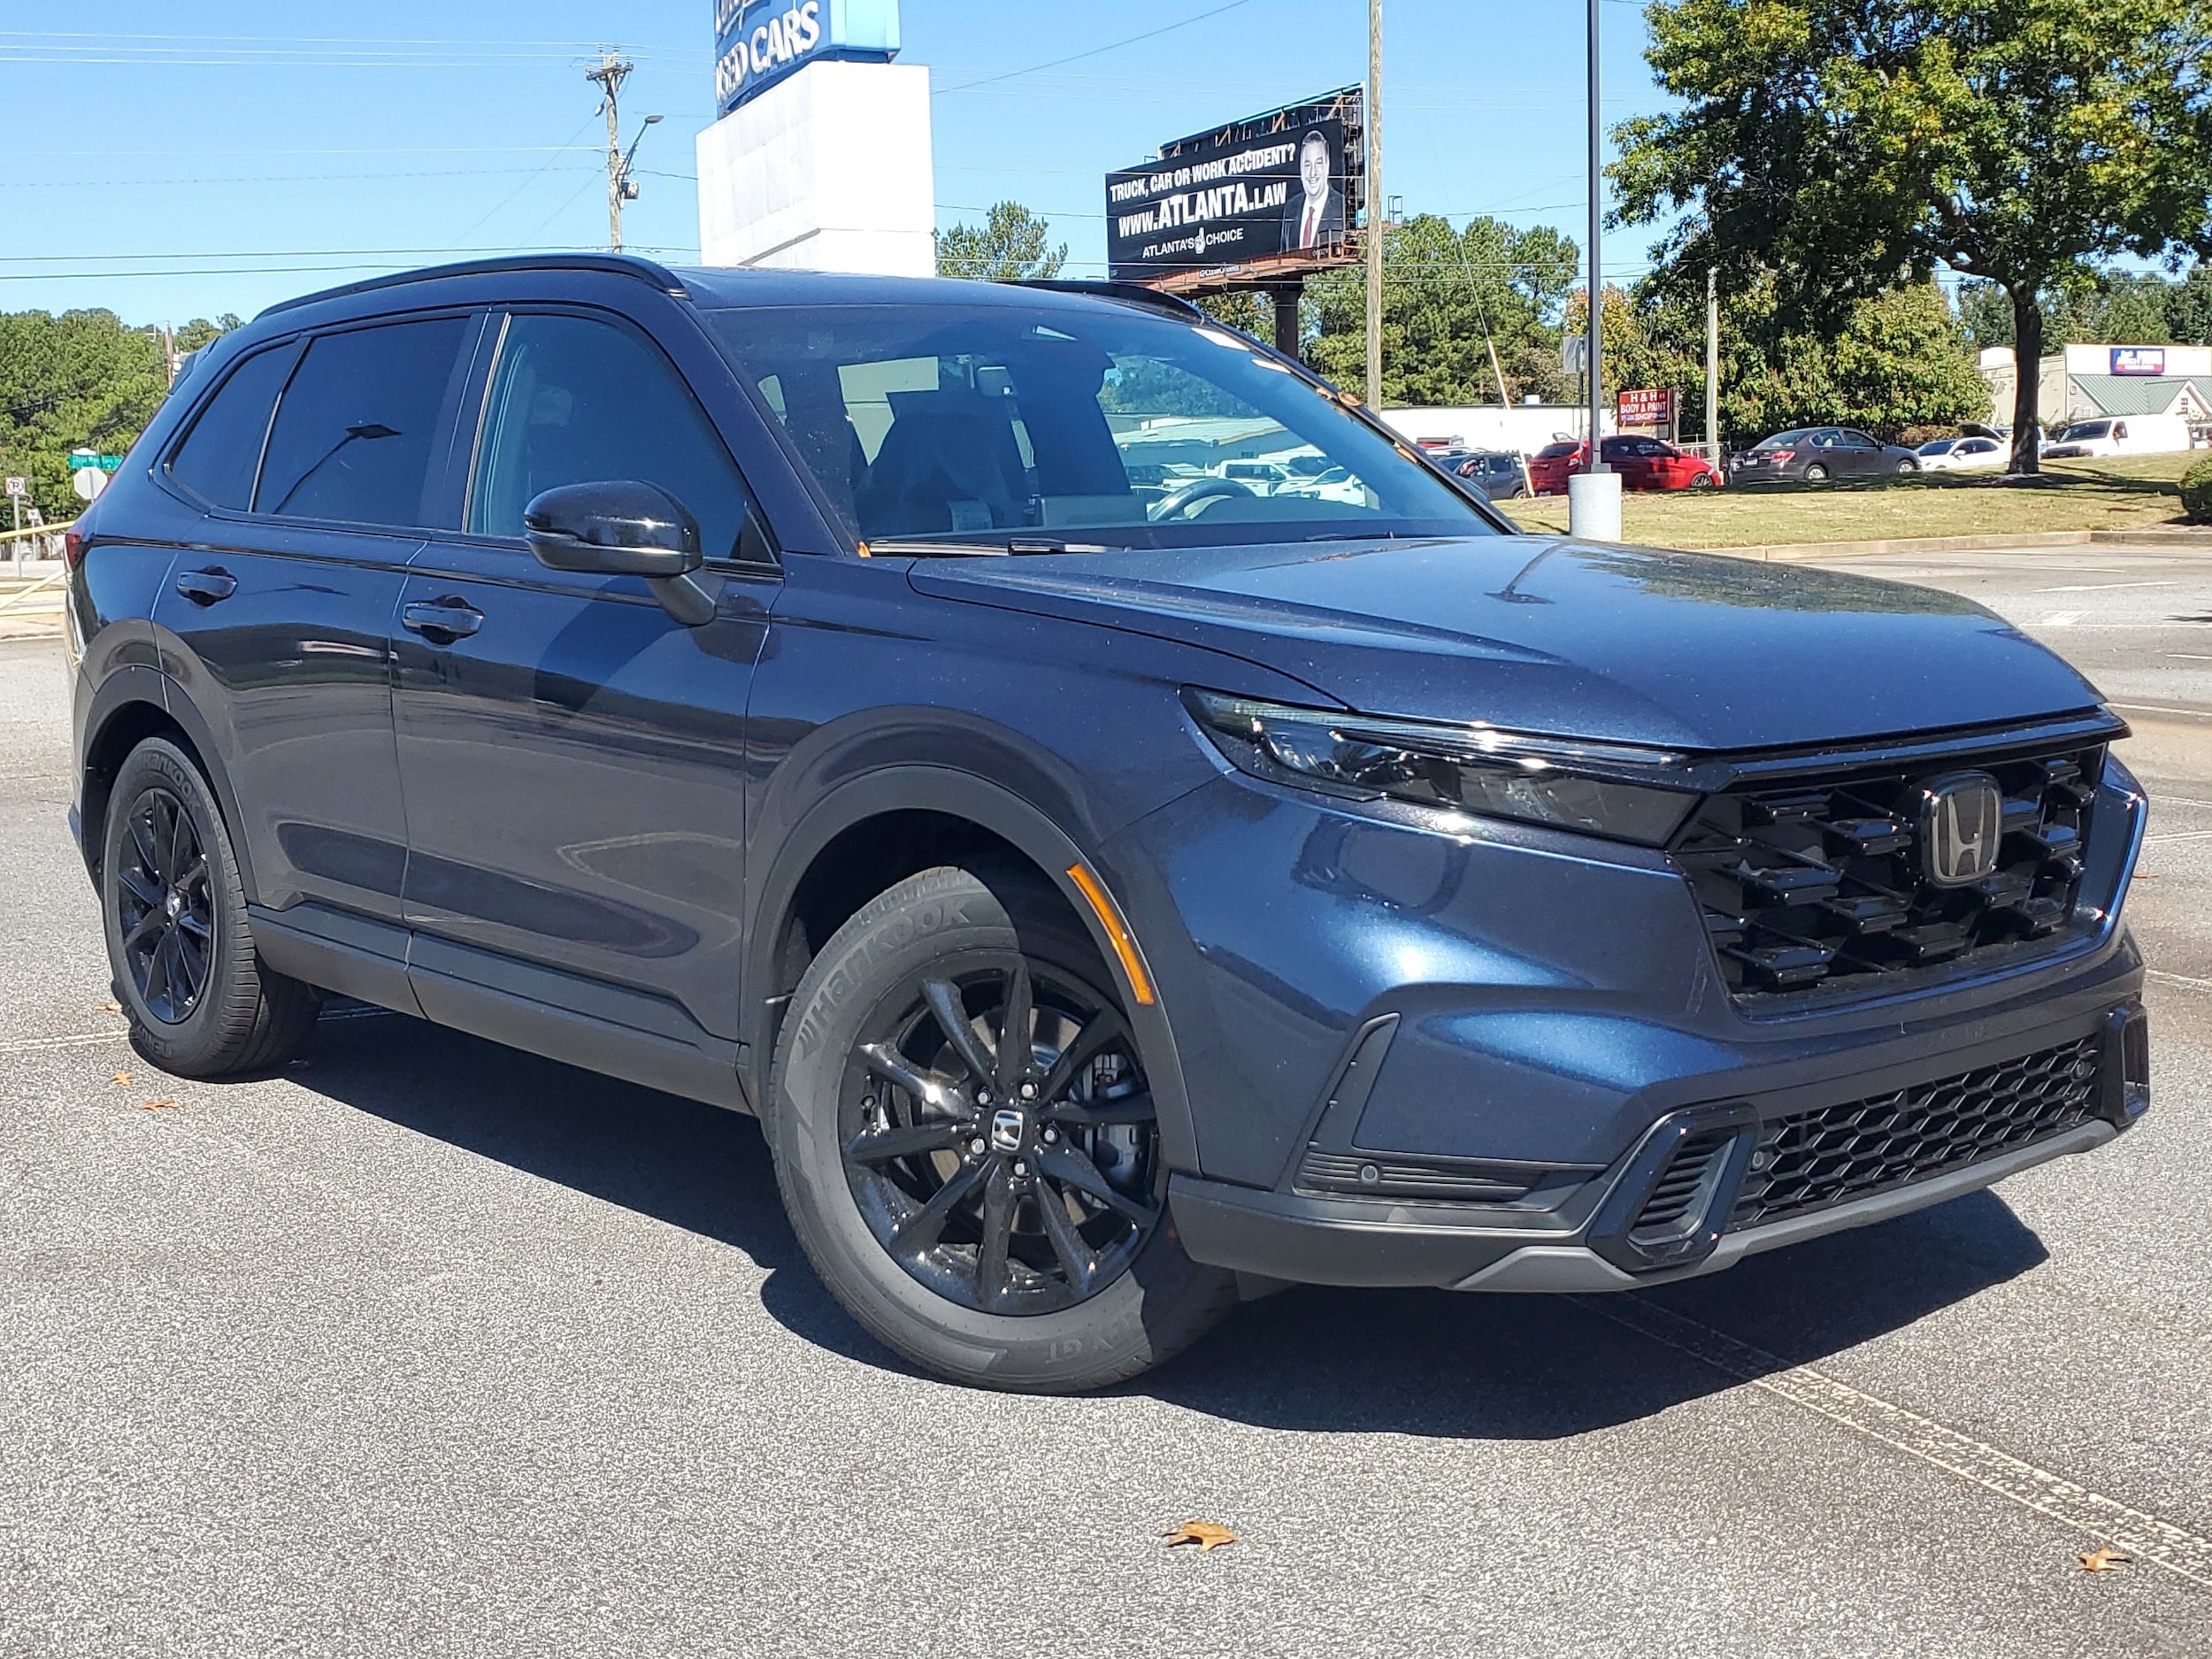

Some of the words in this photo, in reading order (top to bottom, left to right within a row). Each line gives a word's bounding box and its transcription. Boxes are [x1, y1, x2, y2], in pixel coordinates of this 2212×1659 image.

[750, 1, 820, 74] CARS
[1110, 178, 1149, 203] TRUCK,
[1149, 173, 1173, 193] CAR
[1174, 168, 1191, 187] OR
[1191, 163, 1227, 181] WORK
[1227, 142, 1297, 175] ACCIDENT?
[1141, 239, 1195, 259] ATLANTA'S
[1205, 227, 1244, 246] CHOICE
[1620, 403, 1640, 413] BODY
[1647, 401, 1666, 411] PAINT
[1631, 394, 1639, 403] H
[1640, 393, 1647, 402] &
[1649, 392, 1657, 401] H
